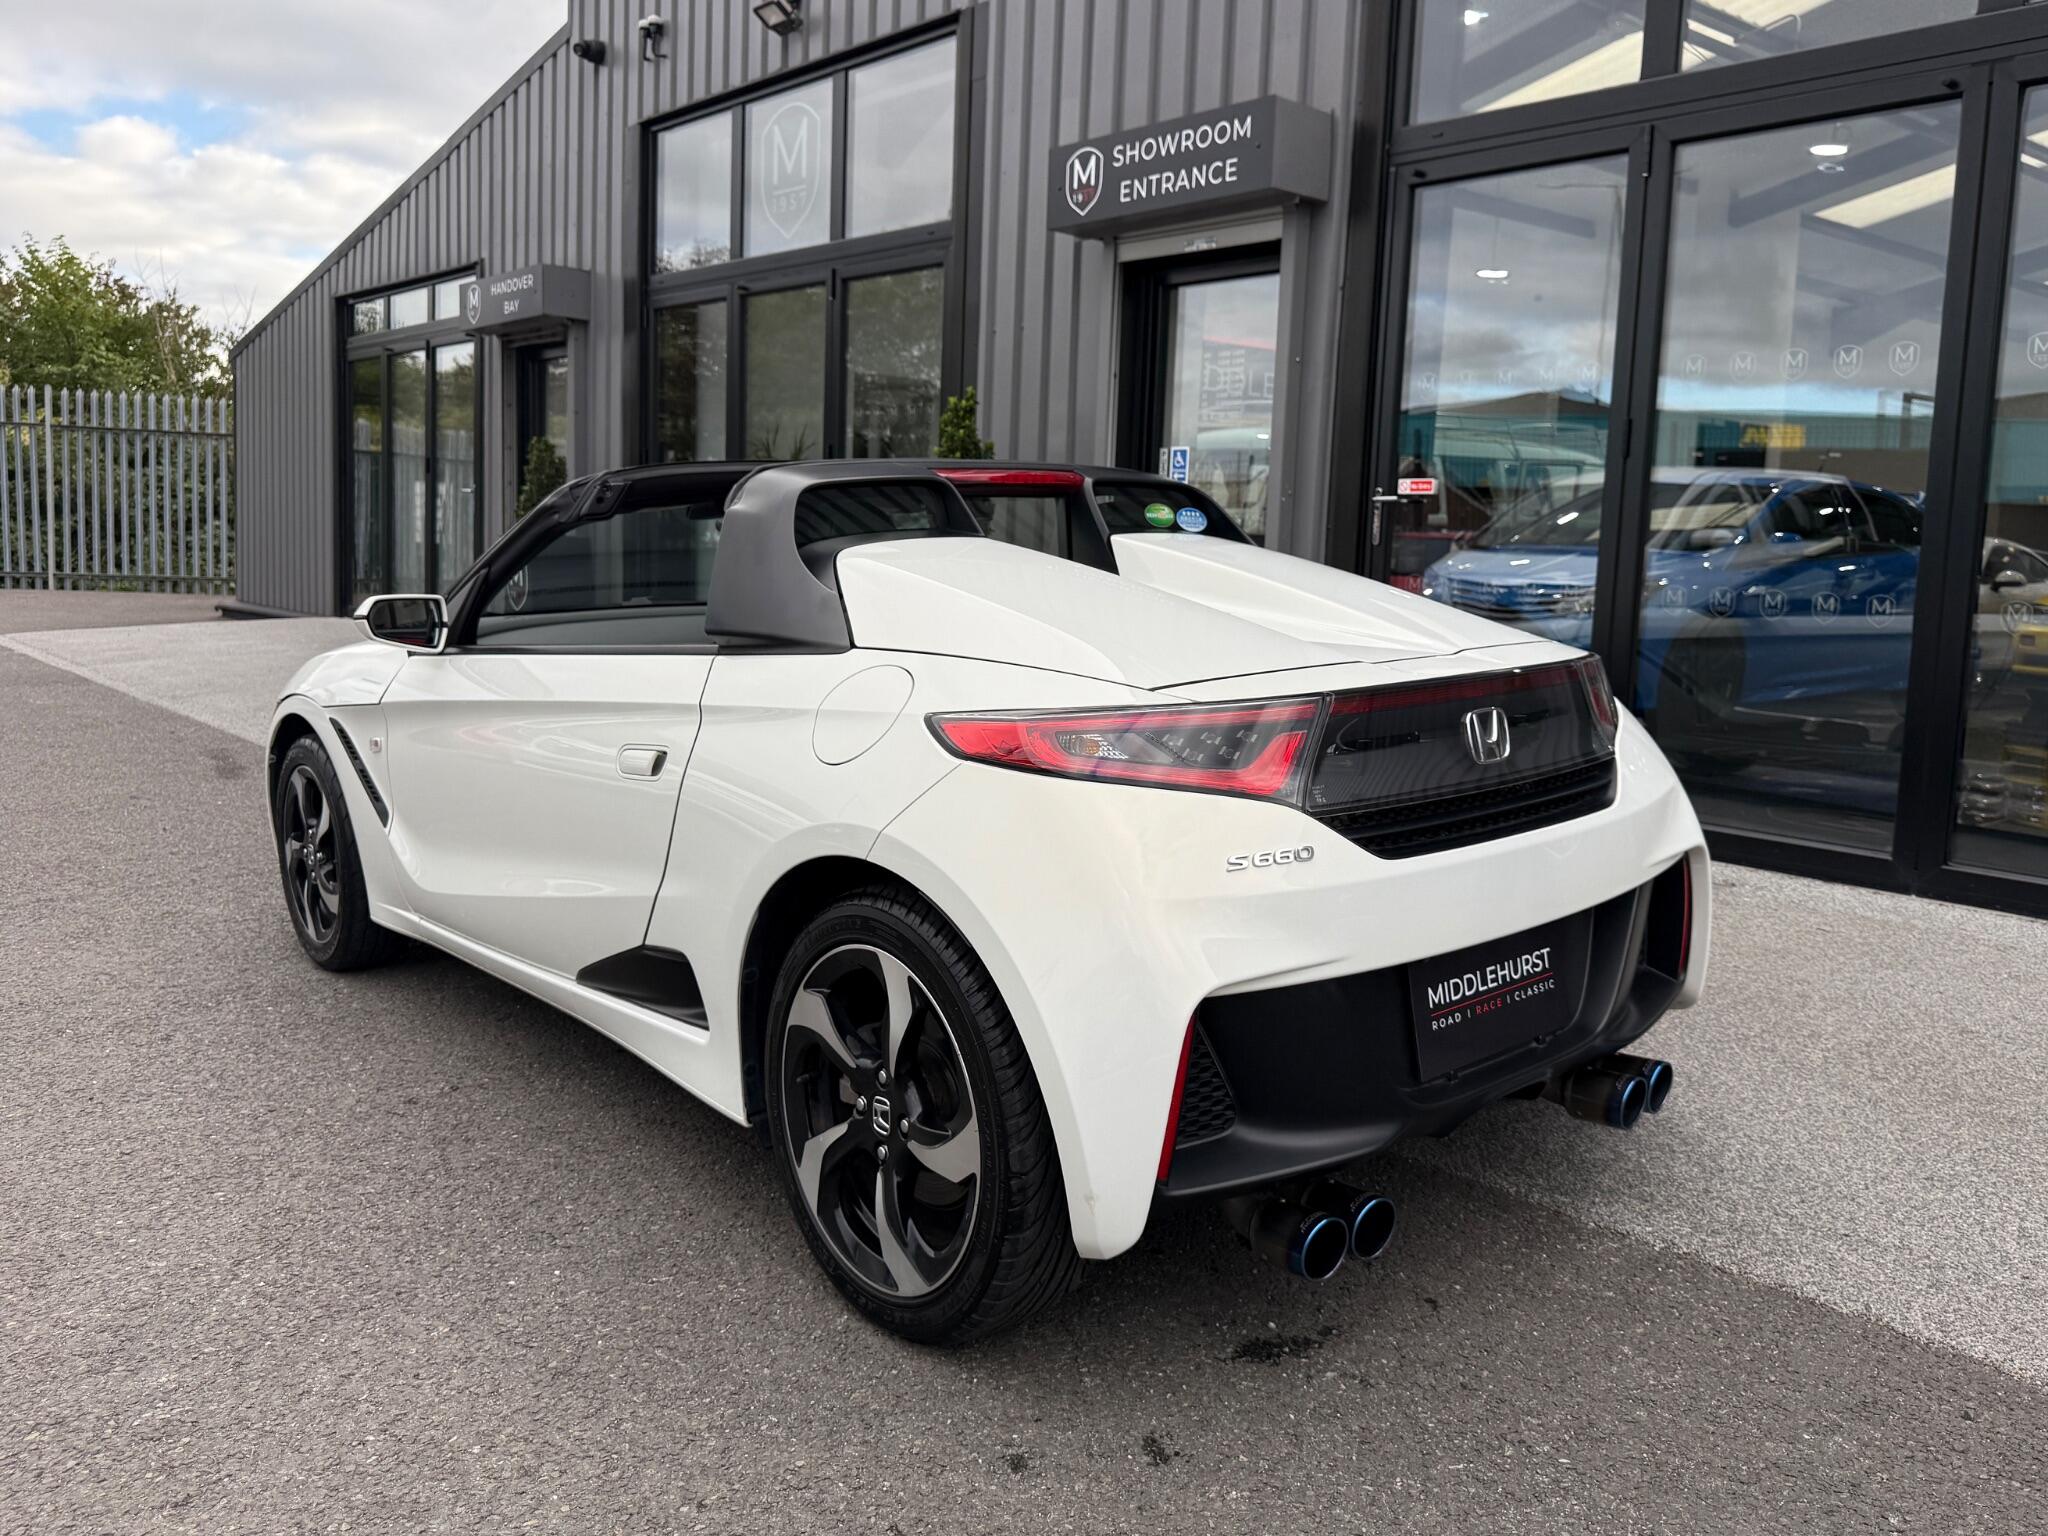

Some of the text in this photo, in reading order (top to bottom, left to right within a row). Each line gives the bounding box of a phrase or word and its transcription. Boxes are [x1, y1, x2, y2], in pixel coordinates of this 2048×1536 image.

[1112, 115, 1252, 168] SHOWROOM
[1073, 153, 1097, 190] M
[1119, 157, 1239, 203] ENTRANCE
[491, 273, 534, 296] HANDOVER
[503, 299, 520, 315] BAY
[1225, 845, 1315, 873] S660
[1427, 947, 1551, 1009] MIDDLEHURST
[1431, 1012, 1462, 1031] ROAD
[1475, 997, 1503, 1016] RACE
[1514, 979, 1556, 1002] CLASSIC
